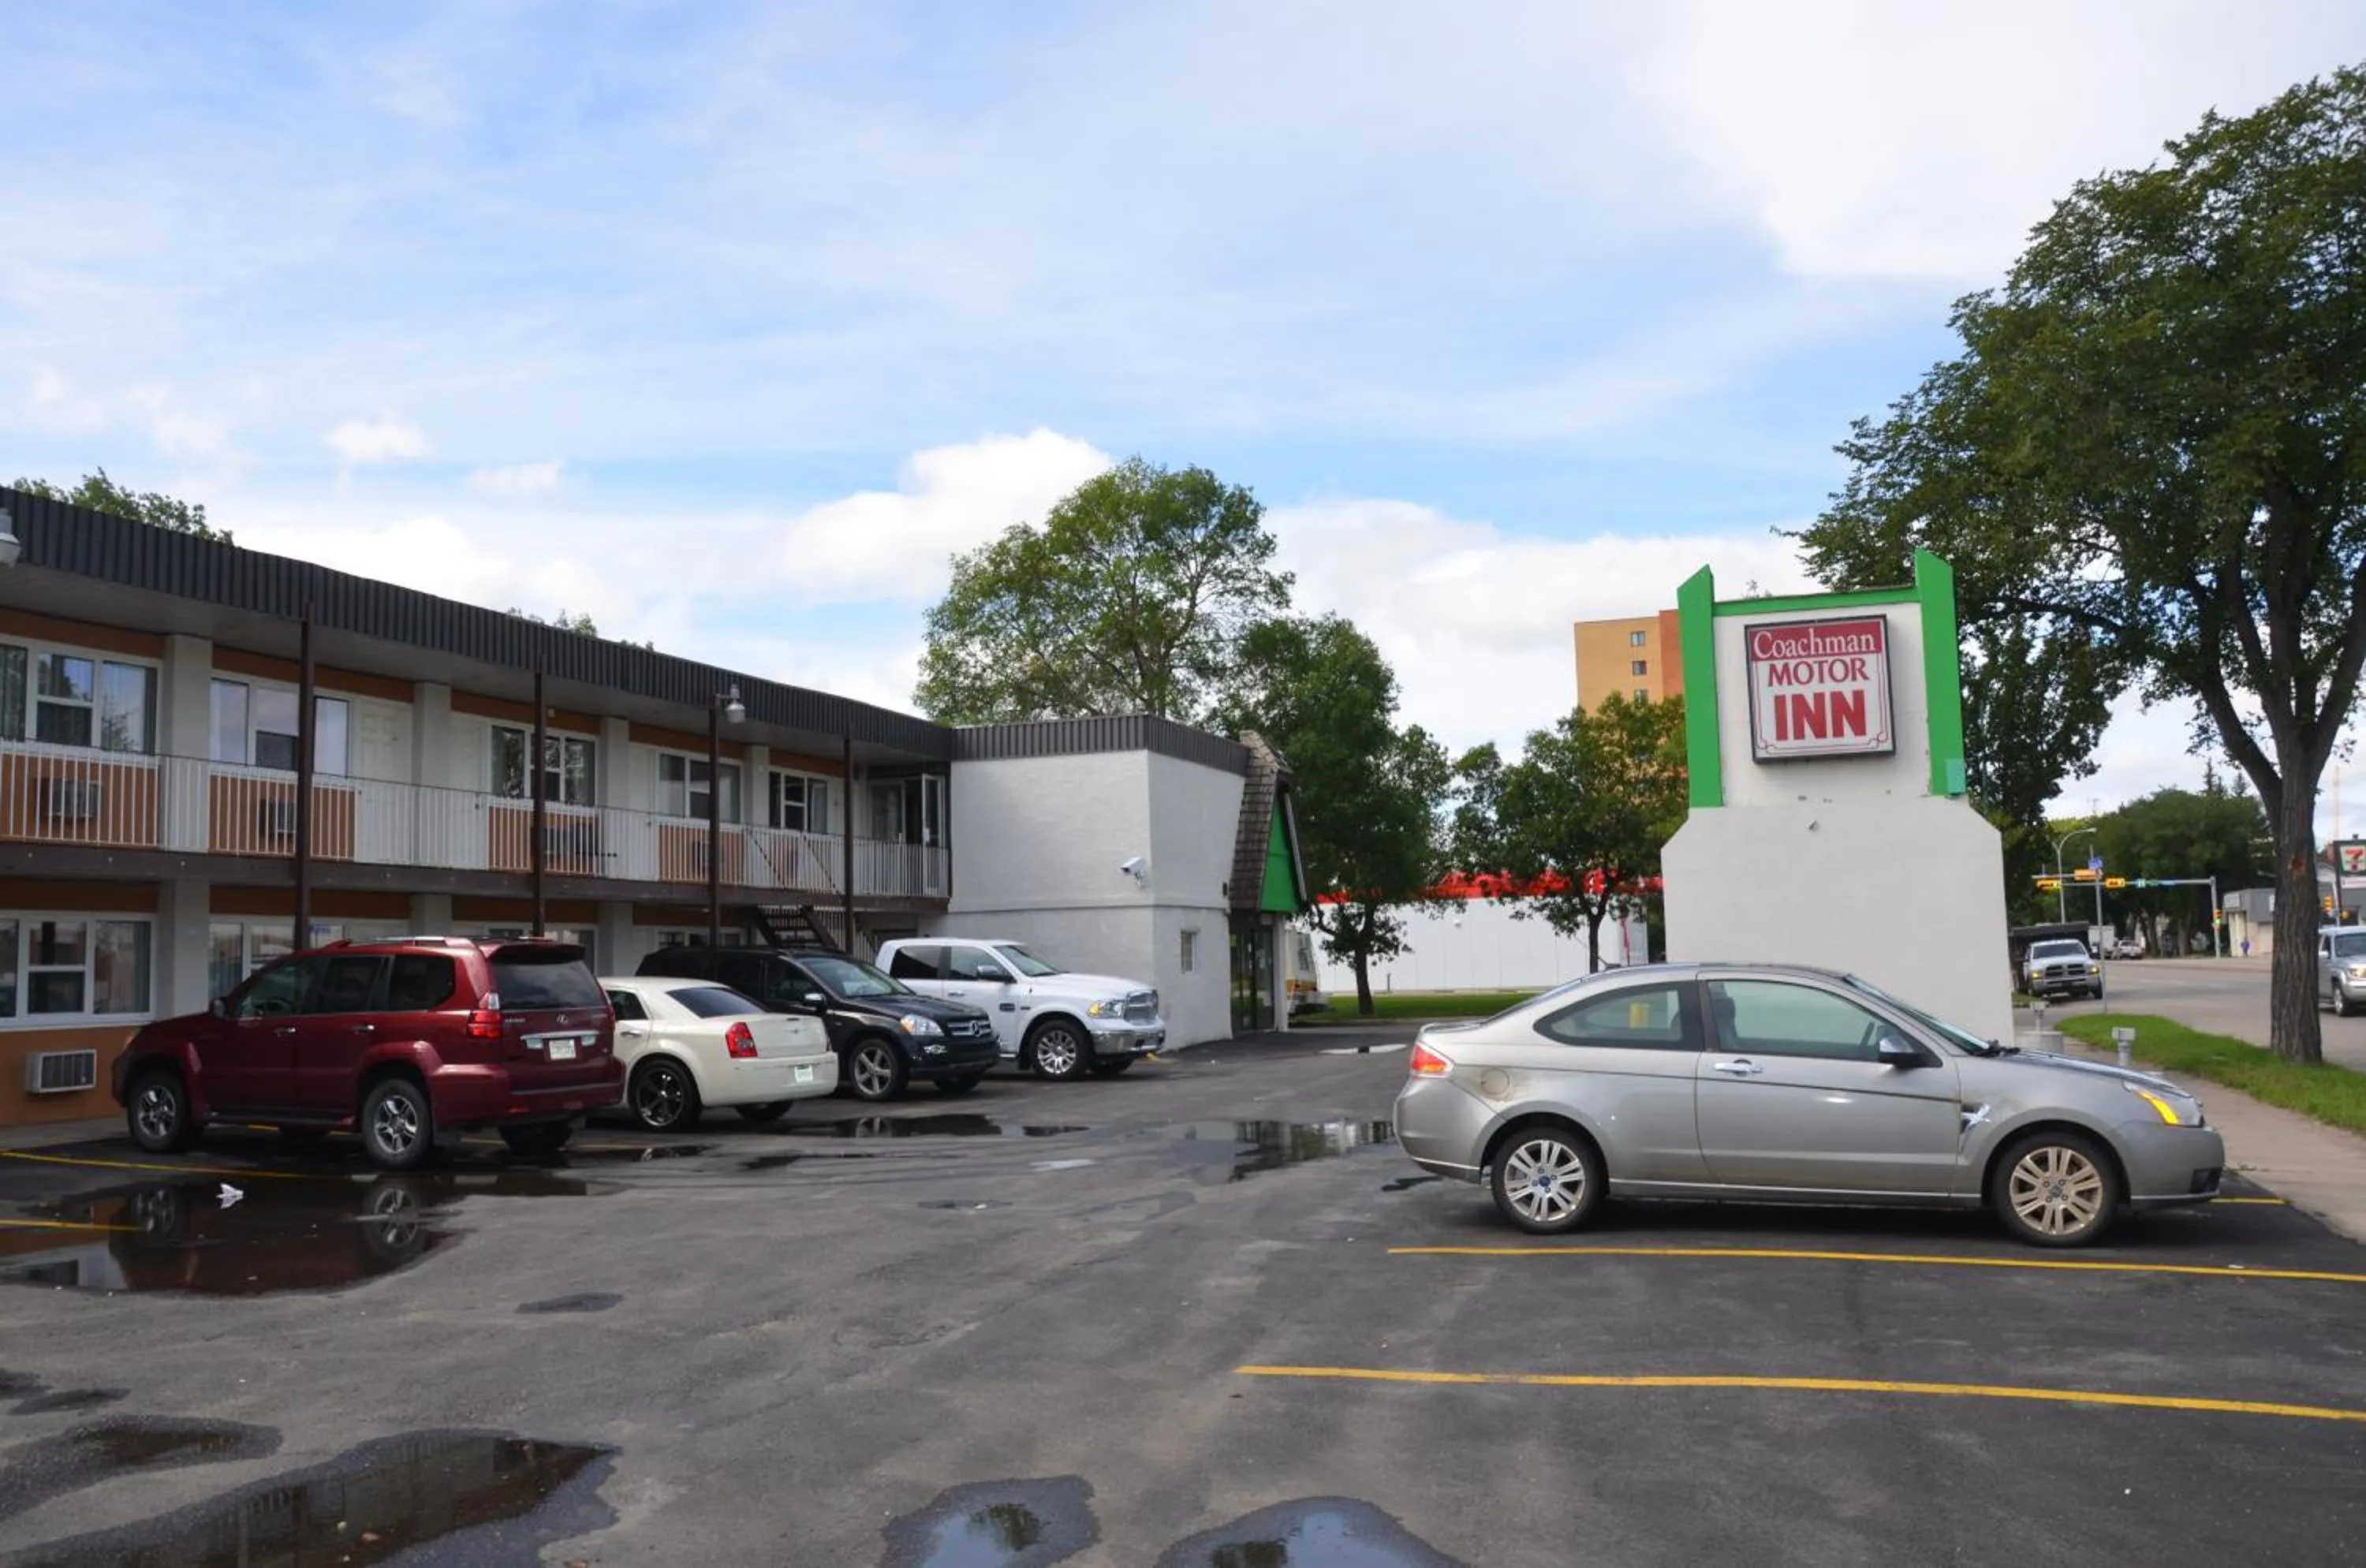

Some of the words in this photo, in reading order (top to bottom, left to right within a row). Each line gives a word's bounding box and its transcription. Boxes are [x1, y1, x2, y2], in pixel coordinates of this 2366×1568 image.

[1754, 628, 1875, 659] Coachman
[1767, 658, 1870, 687] MOTOR
[1774, 689, 1867, 741] INN
